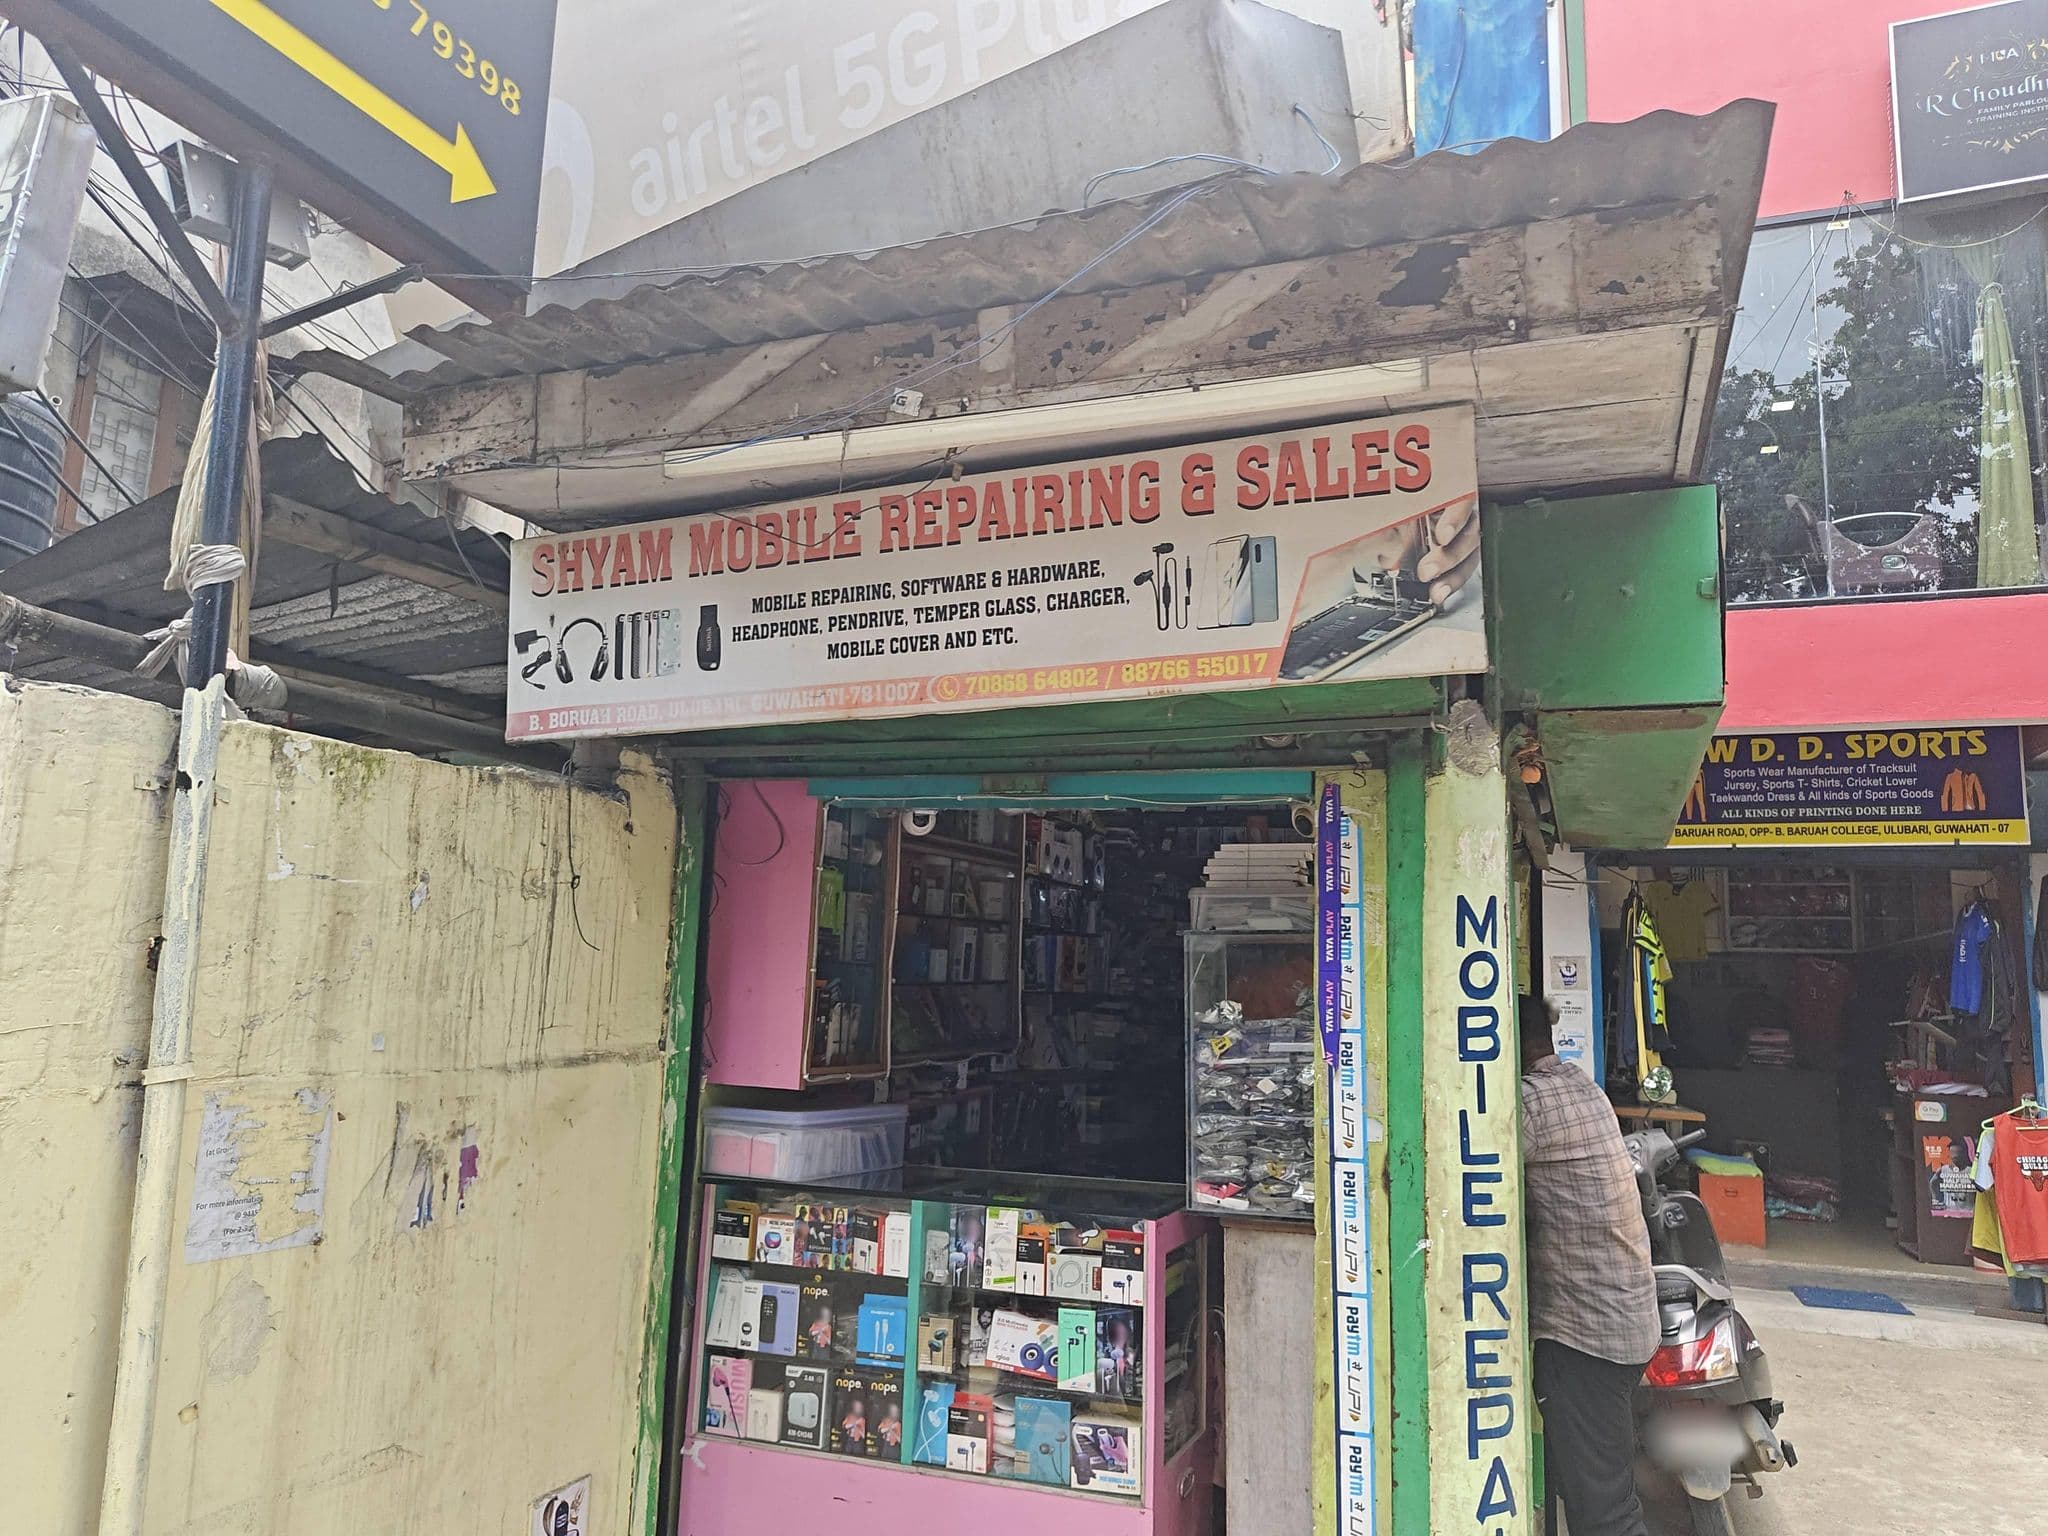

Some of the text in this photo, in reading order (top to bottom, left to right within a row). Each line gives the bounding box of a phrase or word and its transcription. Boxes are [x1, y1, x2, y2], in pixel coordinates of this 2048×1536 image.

[409, 0, 521, 115] 79398
[1975, 111, 2018, 123] TRAINING
[1977, 103, 2011, 115] FAMILY
[629, 64, 815, 217] airtel
[531, 424, 1432, 598] SHYAM MOBILE REPAIRING & SALES
[751, 560, 1106, 614] MOBILE REPAIRING, SOFTWARE & HARDWARE,
[732, 586, 1131, 642] HEADPHONE, PENDRIVE, TEMPER GLASS, CHARGER,
[827, 627, 1019, 660] MOBILE COVER AND ETC.
[1033, 667, 1098, 690] 64802
[1104, 665, 1114, 689] /
[1121, 659, 1190, 683] 88766
[1196, 652, 1269, 677] 55017
[529, 714, 544, 731] B.
[1705, 730, 1988, 763] W D. D. SPORTS
[1724, 763, 1917, 779] Sports Wear Manufacturer of Tracksuit
[1724, 780, 1760, 791] Jursey,
[1762, 779, 1795, 790] Sports
[1811, 777, 1844, 788] Shirts,
[1846, 776, 1883, 787] Cricket
[1885, 776, 1918, 786] Lower
[1326, 799, 1334, 823] TATA
[1710, 789, 1934, 803] Taekwando Dress & All kinds of Sports Goods
[1721, 805, 1922, 819] ALL KINDS OF PRINTING DONE HERE
[1674, 828, 1715, 837] BARUAH
[1717, 827, 1748, 838] ROAD,
[1775, 827, 1786, 836] B.
[1788, 826, 1829, 836] BARUAH
[1831, 825, 1881, 836] COLLEGE,
[1884, 825, 1932, 836] ULUBARI,
[1934, 824, 1989, 834] GUWAHATI
[1998, 823, 2010, 833] 07
[1326, 841, 1334, 892] TATA PLAY
[1326, 910, 1334, 962] TATA PLAY
[1340, 916, 1352, 960] paytm
[1326, 980, 1334, 1033] TATA PLAY
[1341, 1041, 1353, 1087] paytm
[1456, 895, 1507, 1227] MOBILE
[1341, 1106, 1355, 1142] UPI
[196, 1202, 208, 1211] For
[208, 1200, 226, 1209] more
[1342, 1171, 1359, 1219] paytm
[1344, 1238, 1358, 1277] UPI
[1346, 1306, 1362, 1356] paytm
[1347, 1375, 1361, 1415] UPI
[1462, 1252, 1518, 1536] REPA
[1349, 1445, 1365, 1496] paytm
